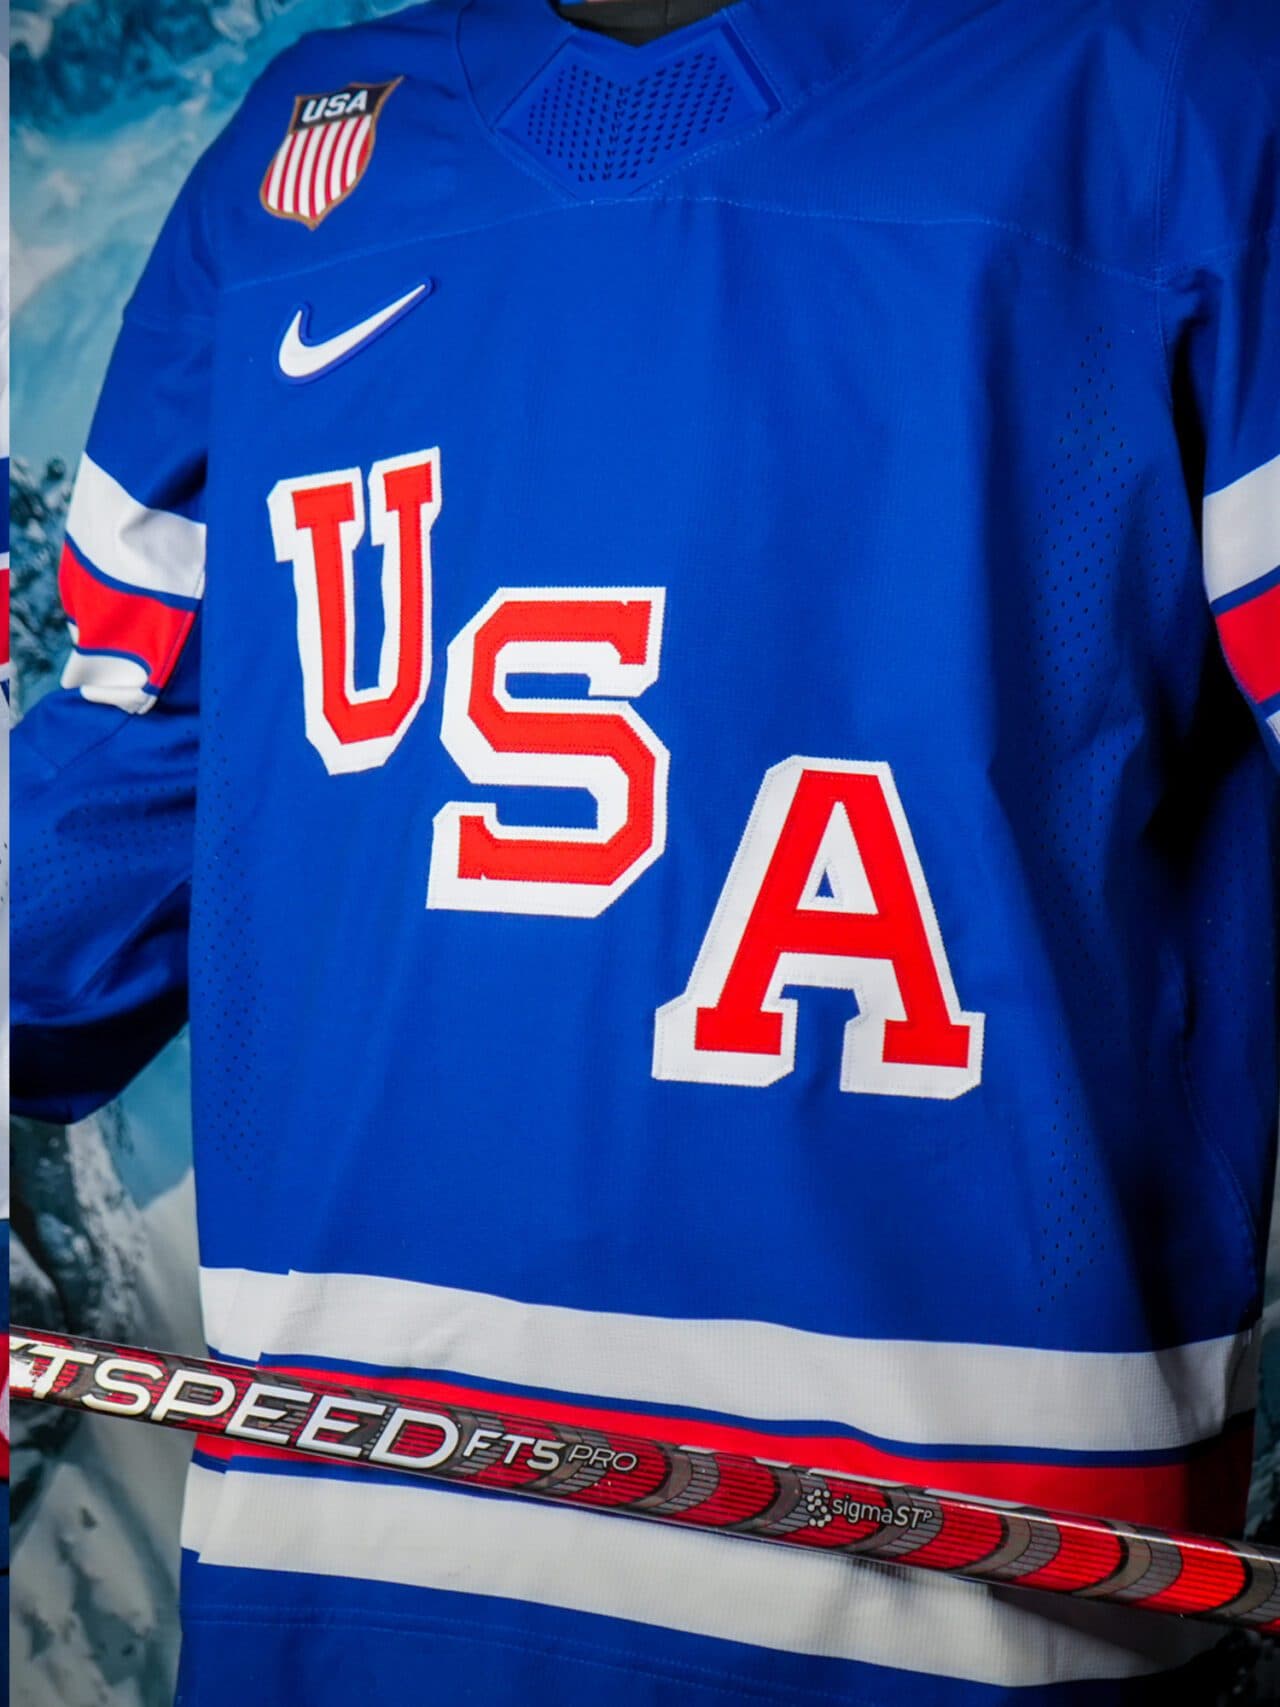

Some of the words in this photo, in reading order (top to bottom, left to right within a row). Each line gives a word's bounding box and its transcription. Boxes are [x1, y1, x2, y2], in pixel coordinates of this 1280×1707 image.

[300, 89, 369, 123] USA
[10, 1335, 460, 1469] TSPEED
[568, 1444, 638, 1472] PRO
